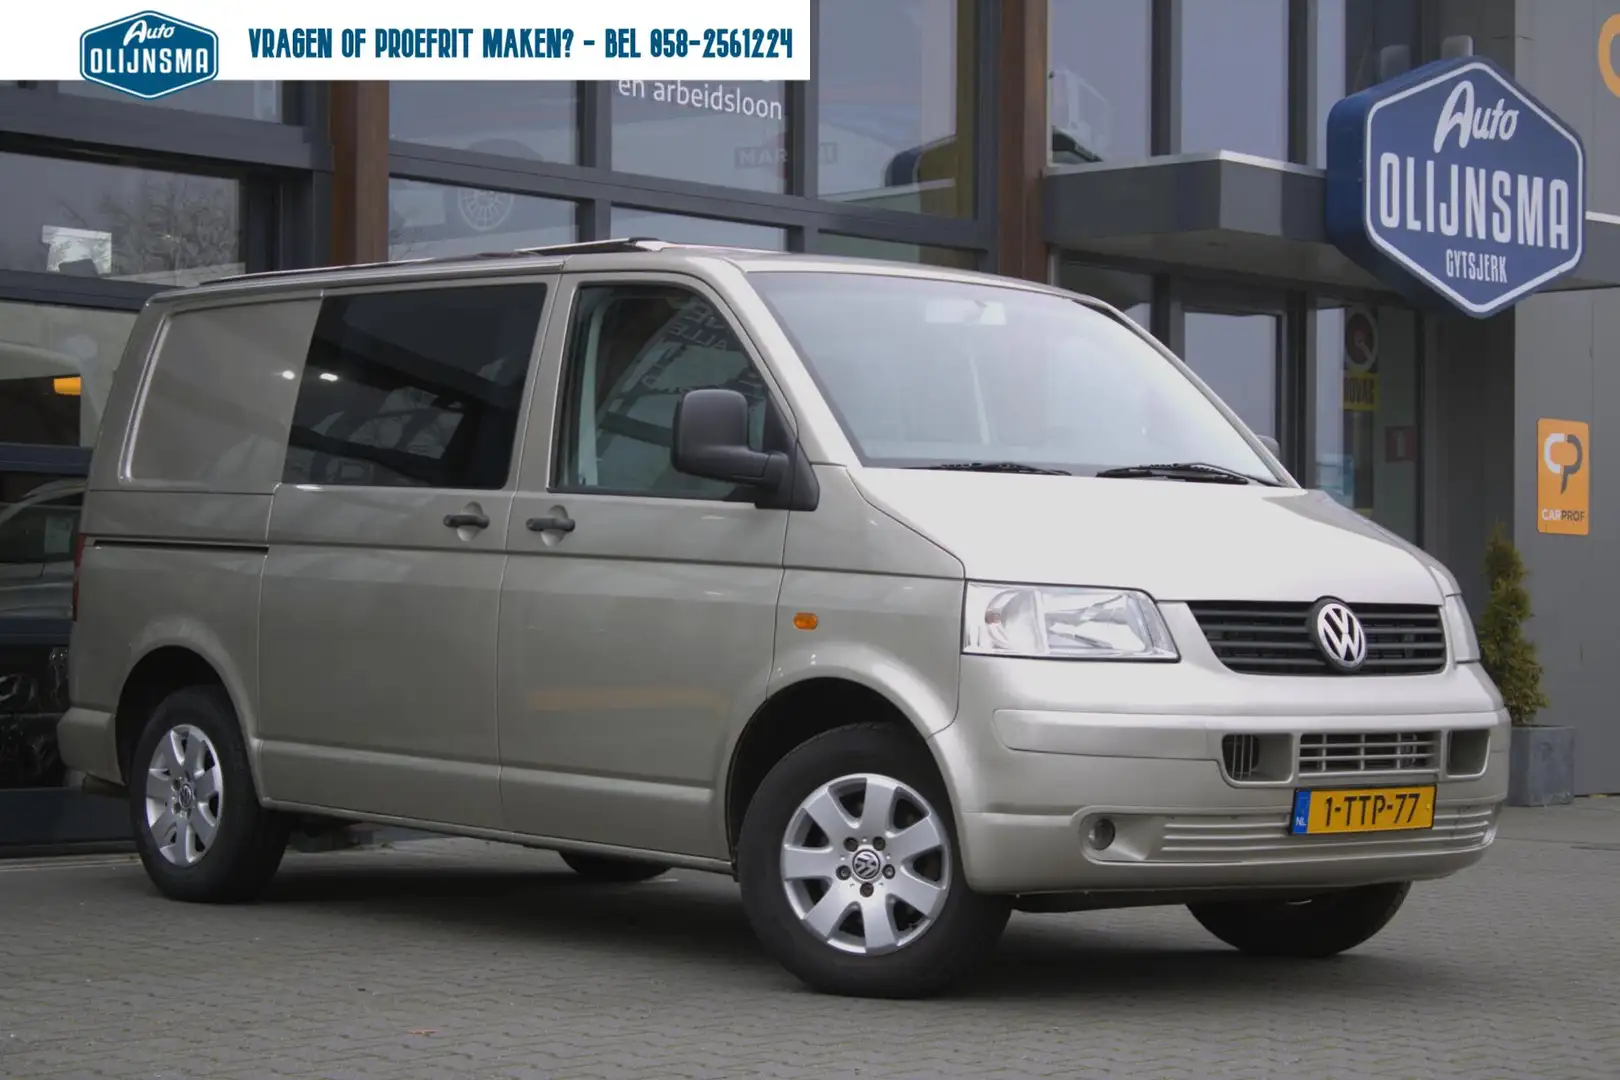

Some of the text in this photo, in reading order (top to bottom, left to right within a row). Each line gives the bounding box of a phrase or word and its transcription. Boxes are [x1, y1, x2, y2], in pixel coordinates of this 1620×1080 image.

[618, 80, 782, 120] en arbeidsloon
[1433, 80, 1520, 154] Auto
[1380, 152, 1570, 251] OLIJNSMA
[1445, 248, 1508, 284] GYTSJERK
[1542, 508, 1585, 522] CARPROF
[1295, 793, 1421, 827] NL 1-TTP-77
